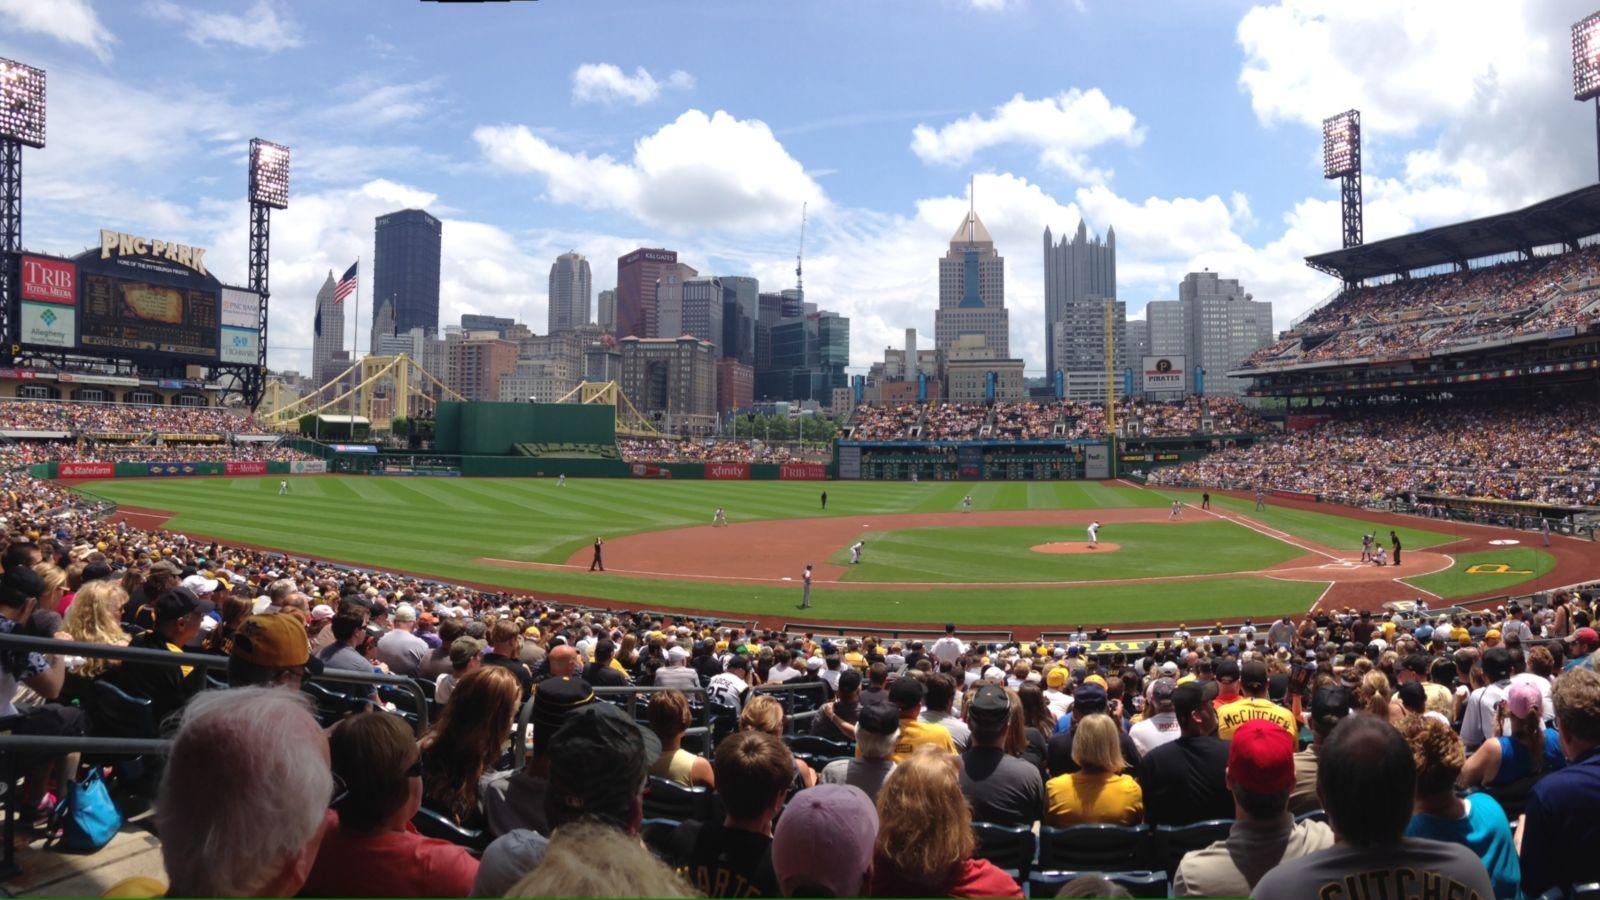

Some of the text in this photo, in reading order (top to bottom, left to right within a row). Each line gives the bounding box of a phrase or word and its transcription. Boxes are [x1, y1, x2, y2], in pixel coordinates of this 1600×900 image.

[100, 229, 207, 277] PNC PARK
[25, 261, 72, 288] TRIB
[25, 283, 72, 299] TOTAL MEDIA
[31, 328, 65, 339] Allegheny
[711, 466, 744, 478] xfinity
